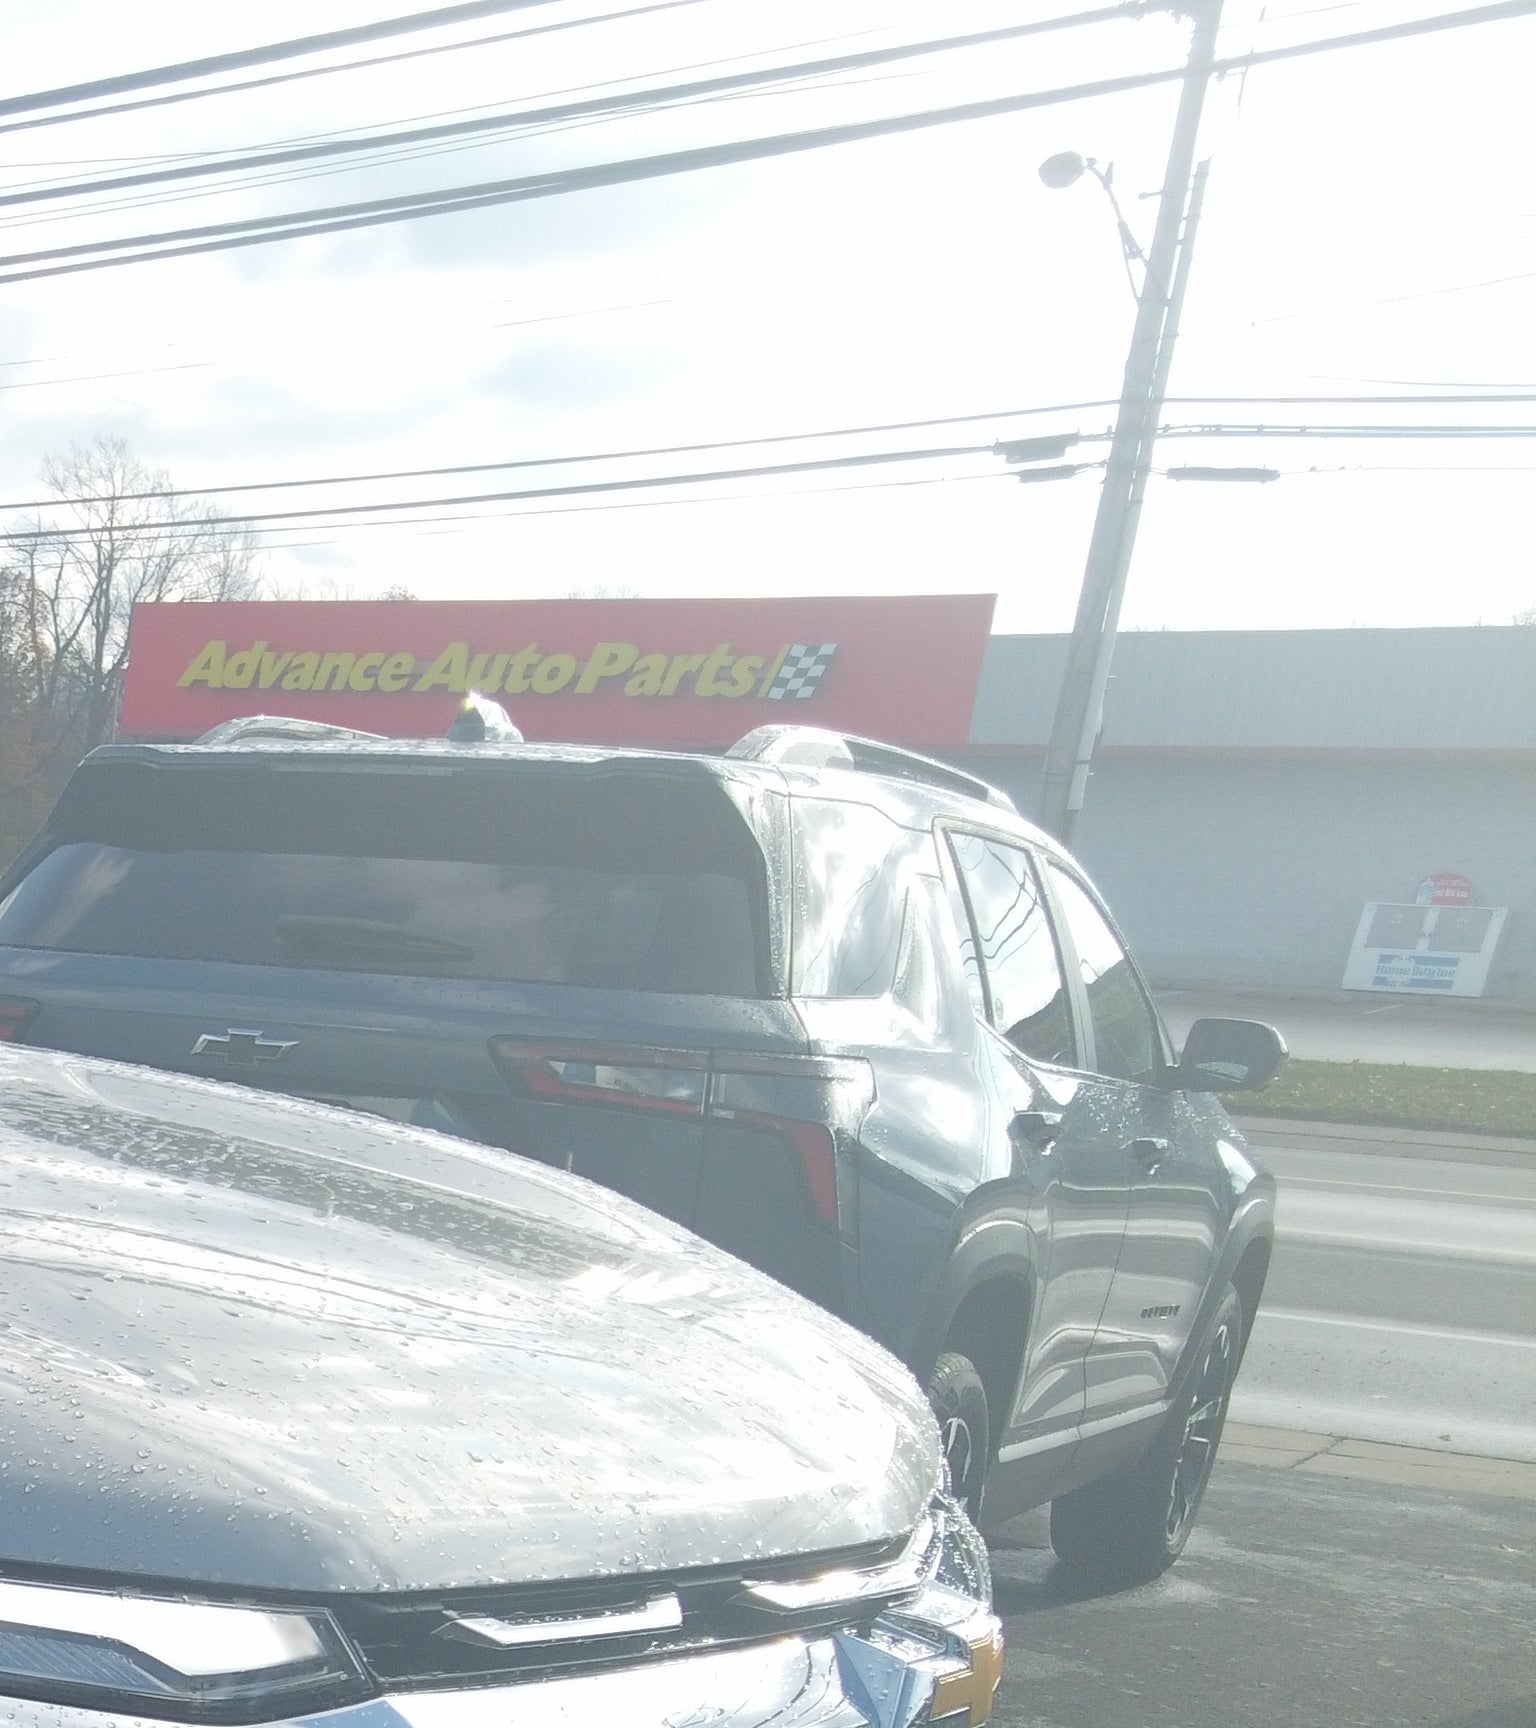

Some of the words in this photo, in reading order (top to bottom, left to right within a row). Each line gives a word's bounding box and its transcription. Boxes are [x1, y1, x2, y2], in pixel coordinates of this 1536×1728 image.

[176, 640, 416, 692] Advance
[412, 641, 577, 694] Auto
[574, 641, 765, 697] Parts
